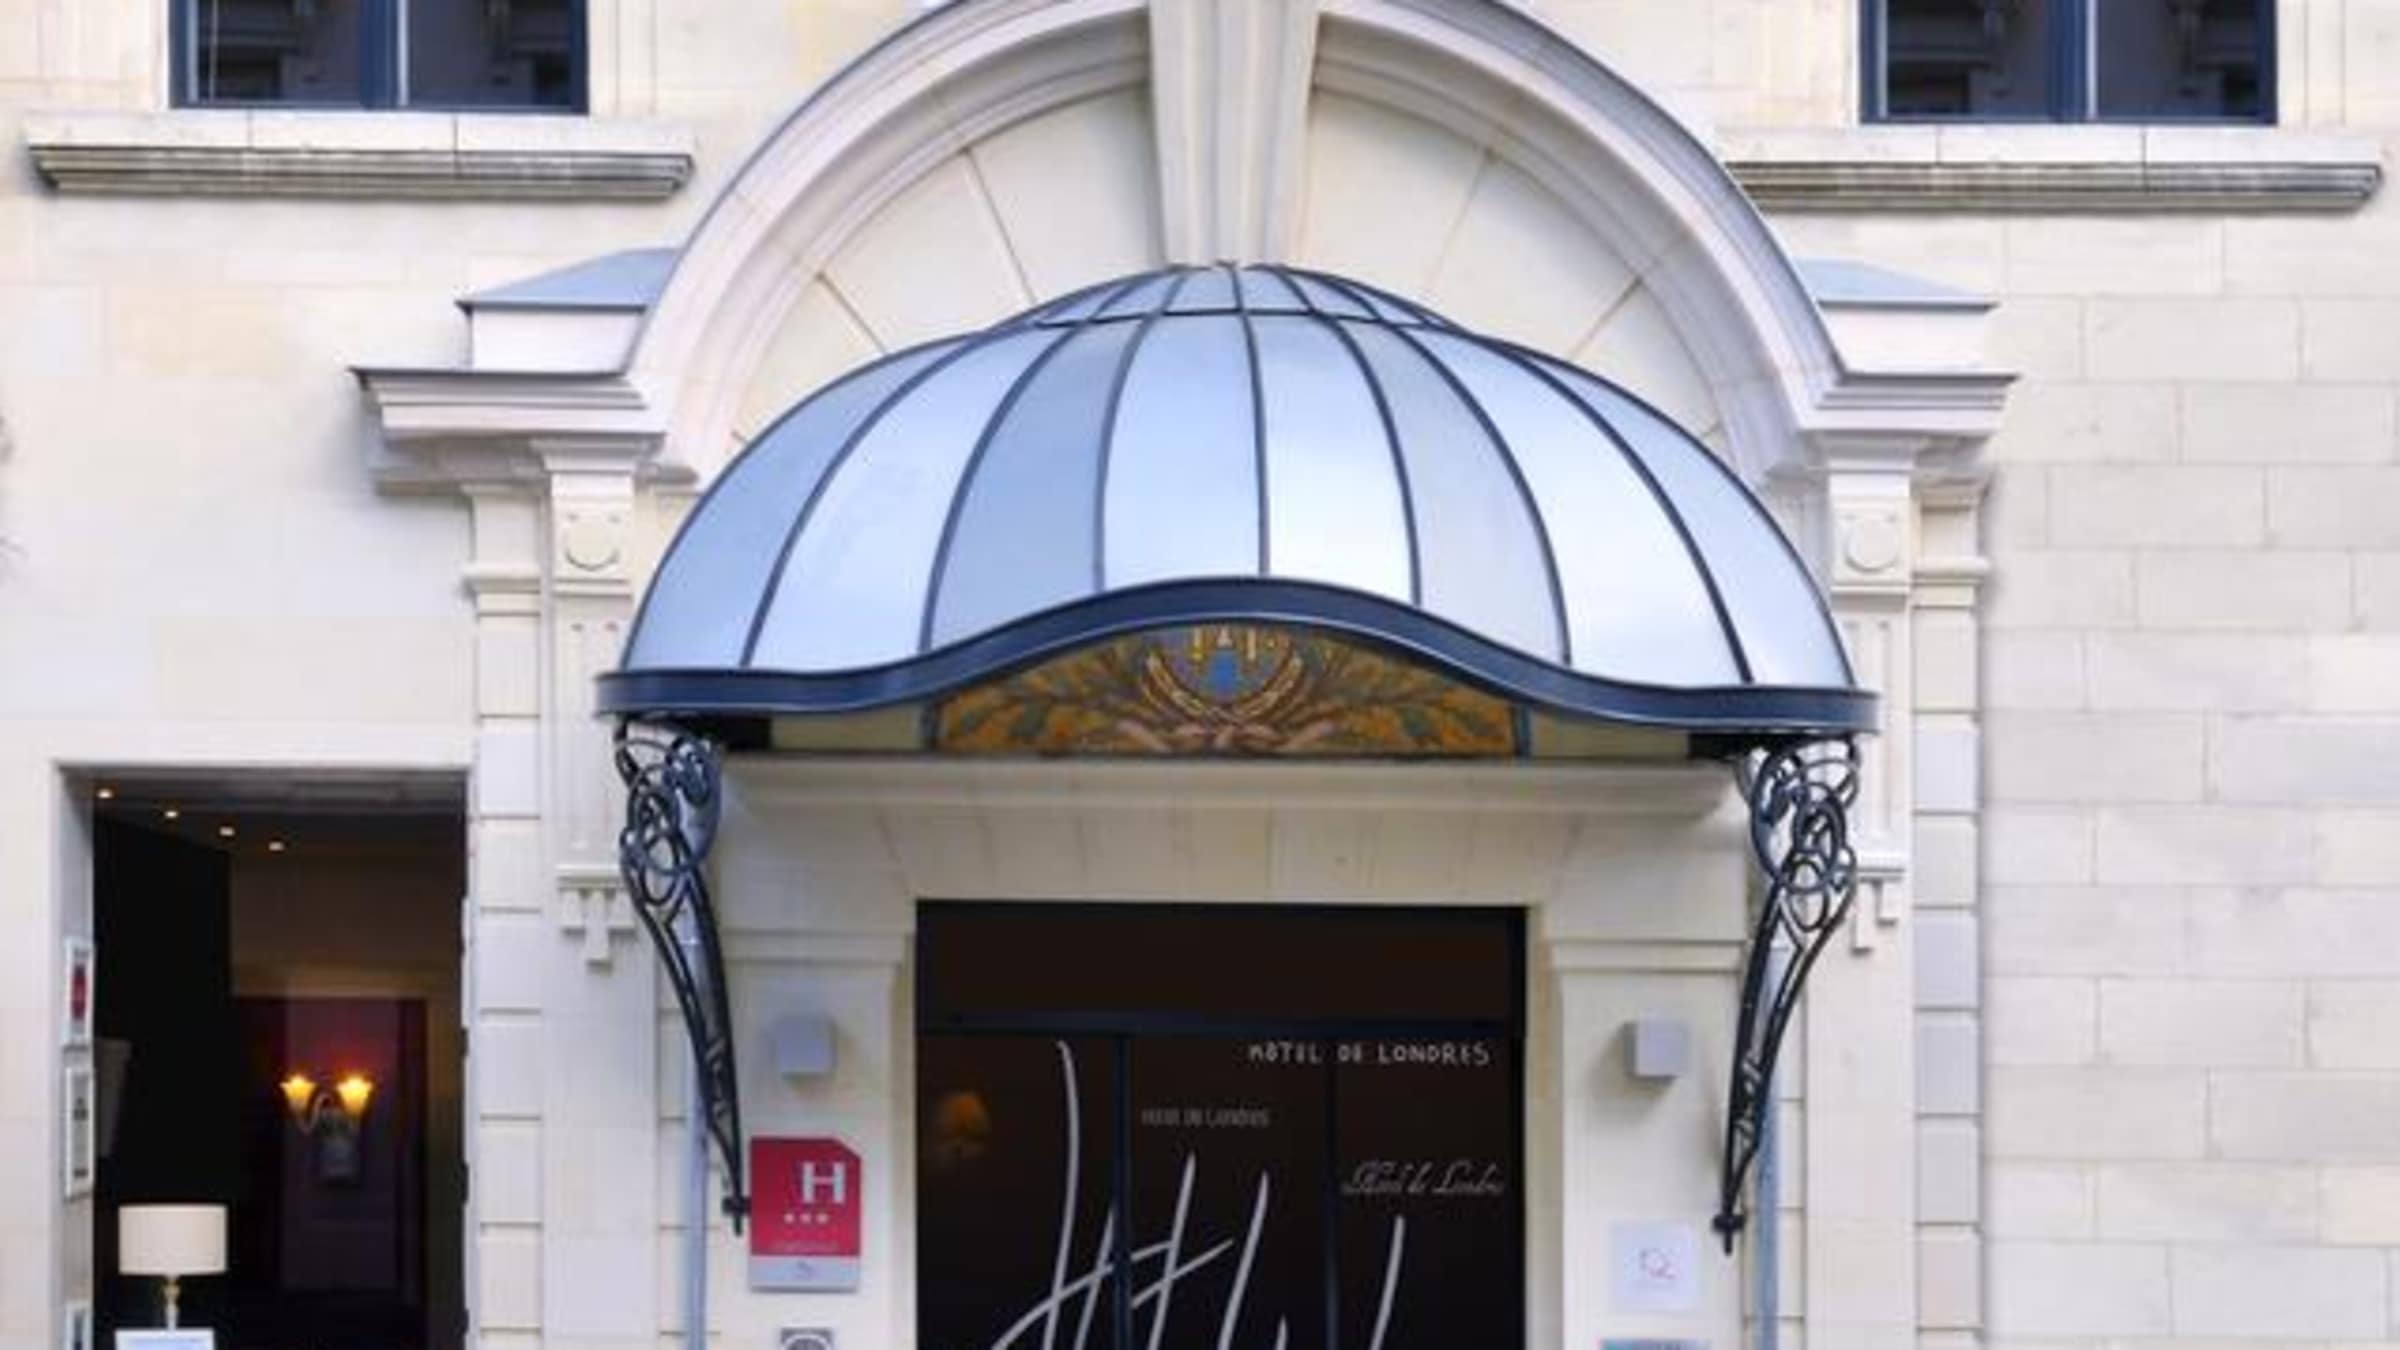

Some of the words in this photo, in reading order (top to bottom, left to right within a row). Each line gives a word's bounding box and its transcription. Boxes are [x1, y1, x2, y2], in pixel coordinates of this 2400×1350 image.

[1337, 1043, 1363, 1063] DE
[1378, 1041, 1490, 1066] LONDRES
[802, 1161, 846, 1205] H
